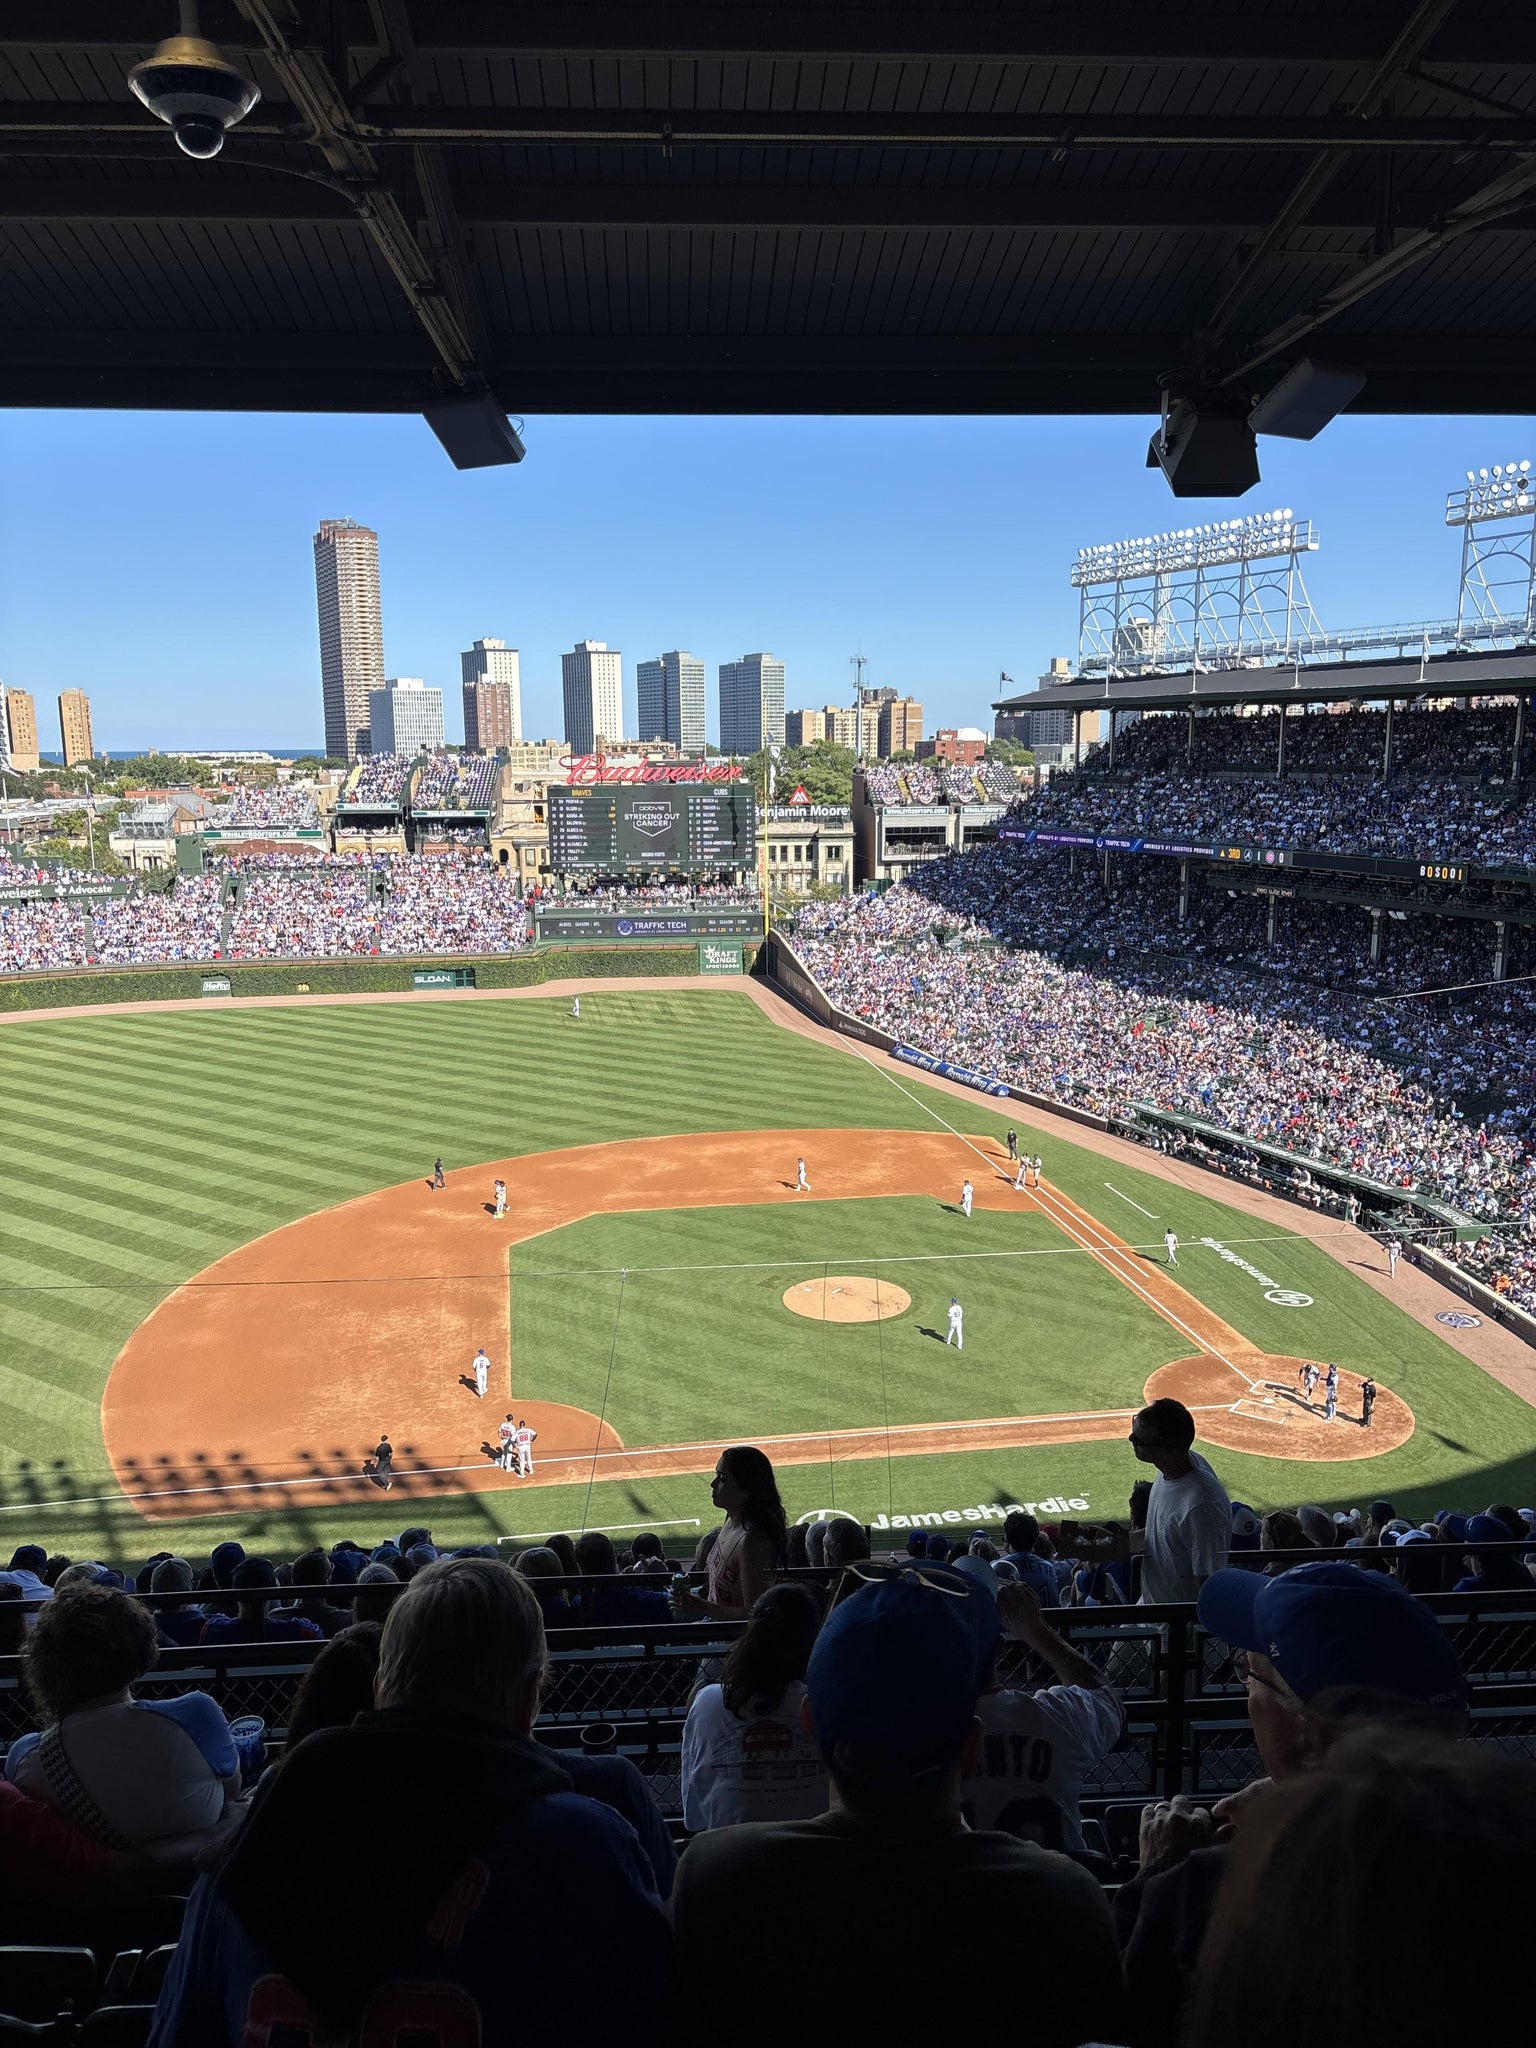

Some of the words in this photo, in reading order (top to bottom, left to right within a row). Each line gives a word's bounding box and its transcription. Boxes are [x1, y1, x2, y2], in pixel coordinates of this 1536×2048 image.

[559, 753, 743, 785] Budweiser
[754, 806, 806, 820] Benjamin
[1228, 848, 1241, 859] 3RD
[68, 885, 112, 894] Advocate
[706, 951, 737, 959] DRAFT
[895, 1049, 918, 1064] Reynolds
[916, 1056, 931, 1070] Wrap
[946, 1066, 972, 1083] Reynolds
[970, 1074, 987, 1089] Wrap
[1200, 1236, 1280, 1288] JamesHardie
